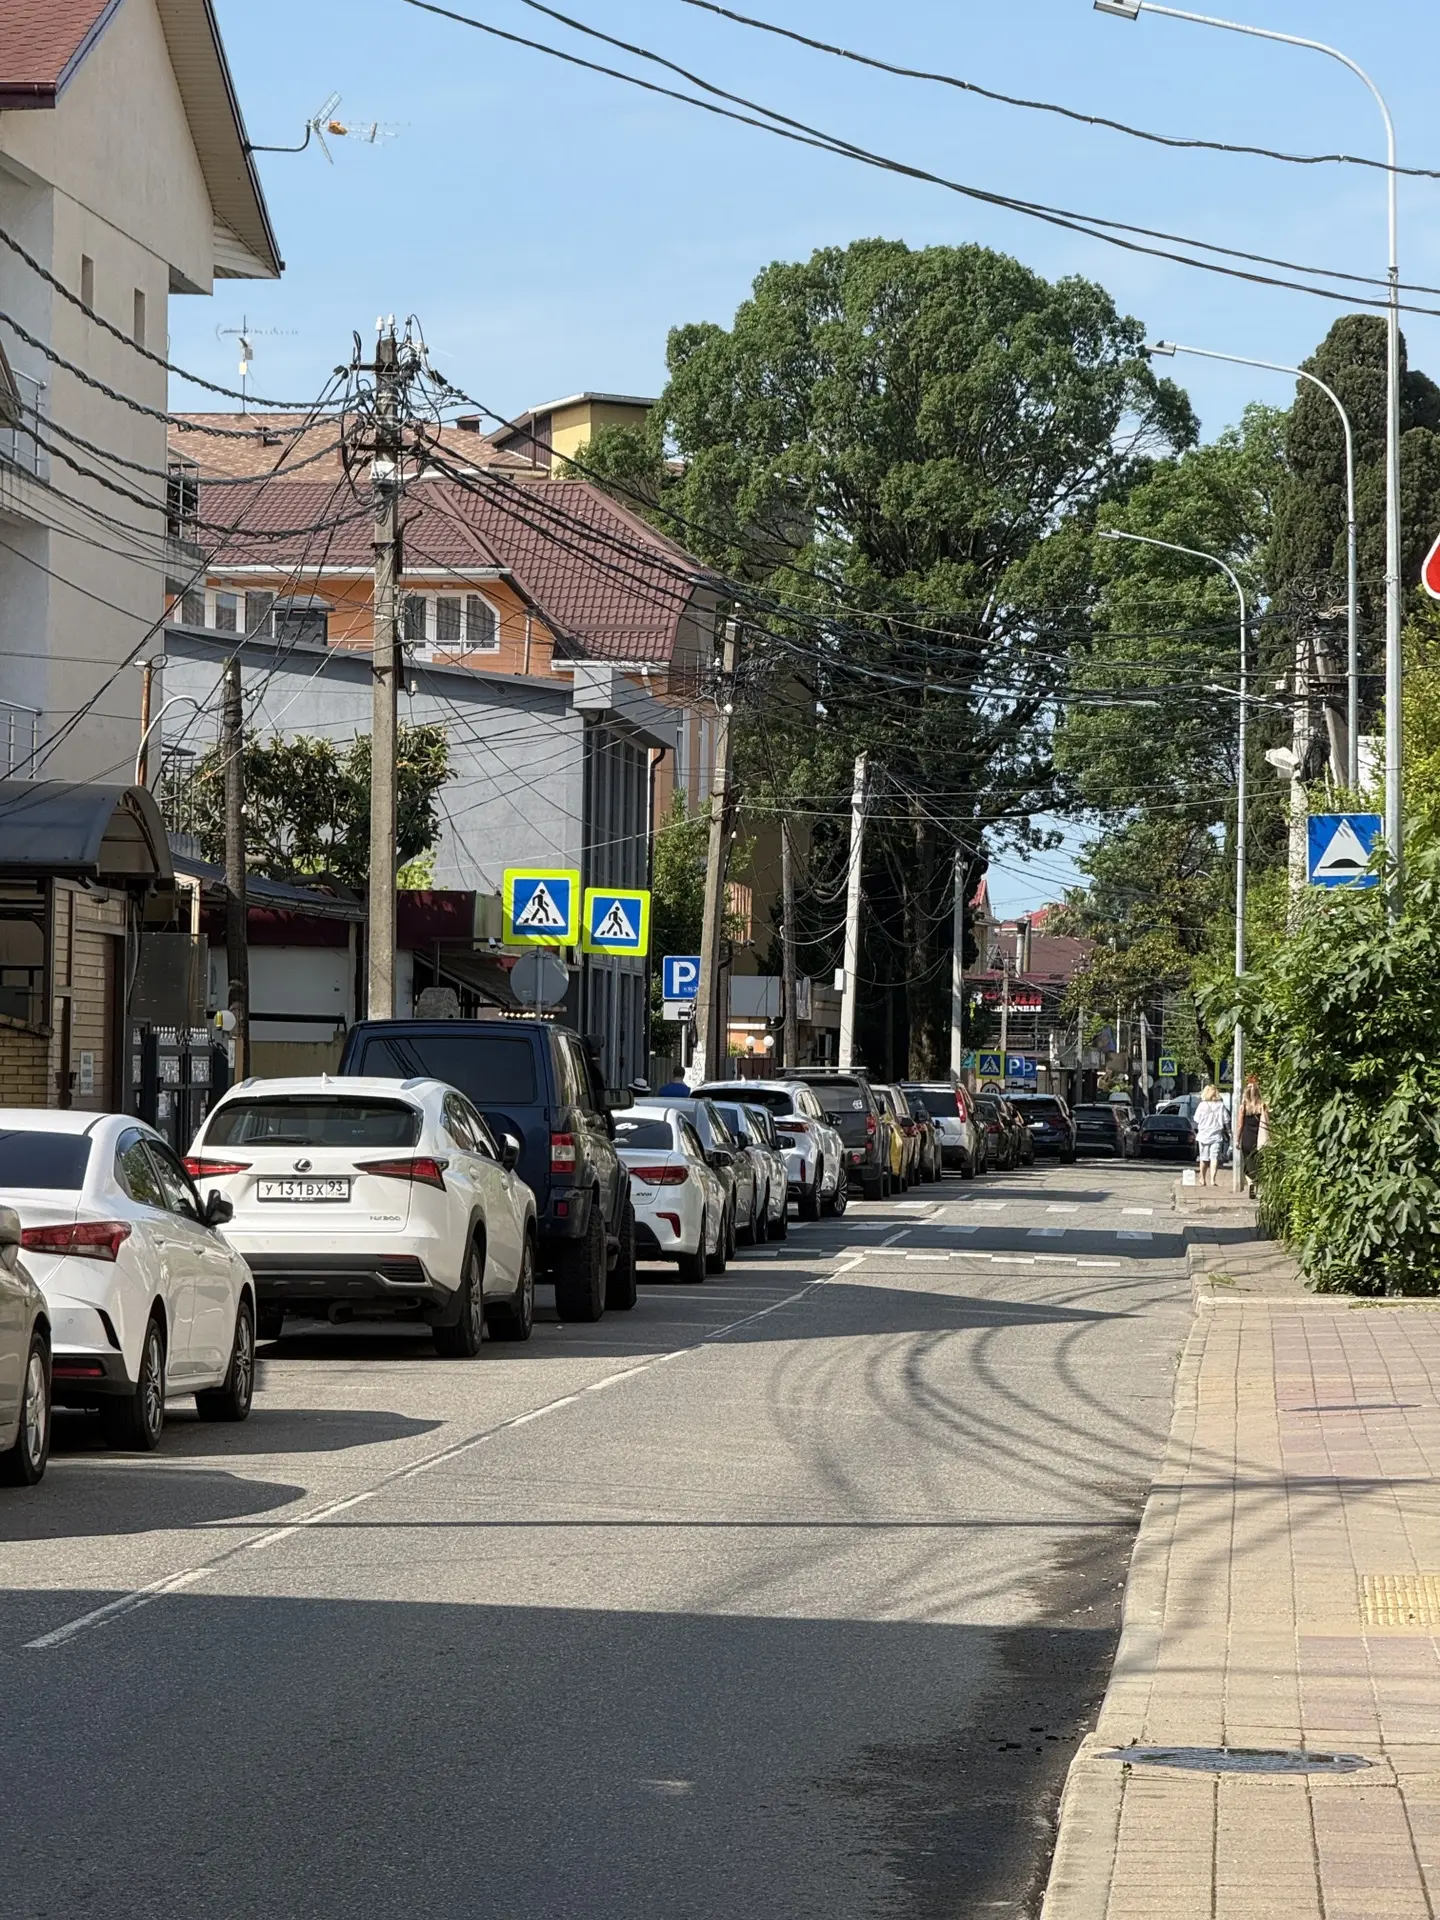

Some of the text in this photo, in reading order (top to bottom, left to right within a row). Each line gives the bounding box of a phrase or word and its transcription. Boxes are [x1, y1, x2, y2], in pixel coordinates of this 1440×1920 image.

[673, 961, 696, 994] P
[1008, 1058, 1020, 1074] P
[328, 1180, 343, 1192] 93
